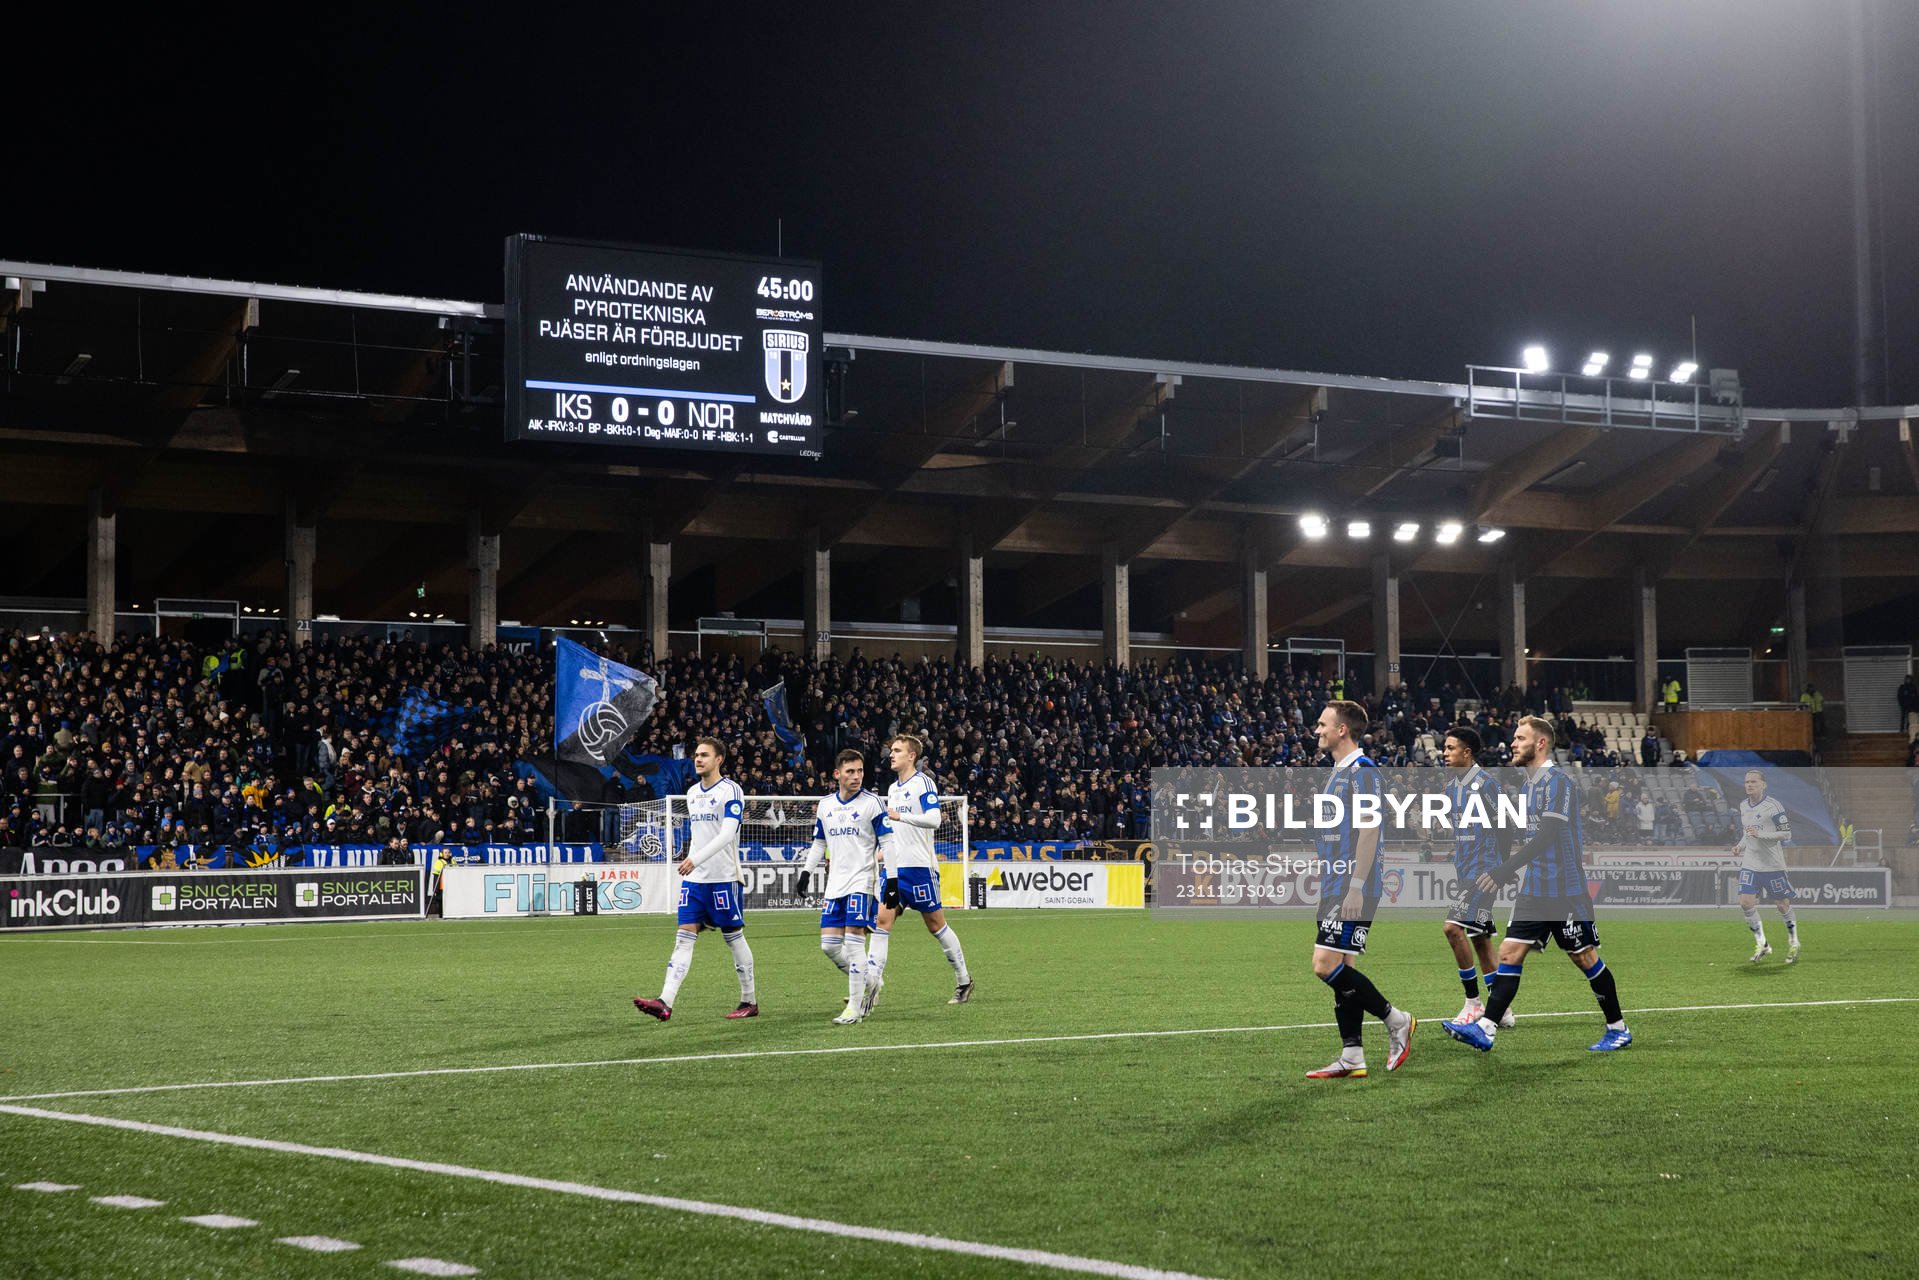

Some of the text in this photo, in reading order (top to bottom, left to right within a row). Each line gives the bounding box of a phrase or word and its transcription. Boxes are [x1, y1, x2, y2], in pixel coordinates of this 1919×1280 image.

[565, 274, 714, 302] ANVÄNDANDE AV
[757, 276, 813, 302] 45:00
[574, 298, 706, 325] PYROTEKNISKA
[539, 319, 743, 352] PJÄSER ÄR FÖRBJUDET
[767, 333, 805, 350] SIRIUS
[585, 352, 700, 371] enligt ordningslagen
[555, 392, 593, 420] IKS
[611, 396, 629, 423] 0
[657, 399, 675, 426] 0
[688, 401, 735, 429] NOR
[760, 411, 812, 426] MATCHVÅRD
[297, 620, 311, 631] 21
[817, 631, 830, 642] 20
[1388, 663, 1400, 673] 19
[1009, 866, 1093, 891] weber
[1584, 870, 1606, 880] EAM
[1625, 871, 1639, 880] EL
[1639, 871, 1648, 880] &
[1648, 871, 1668, 880] VVS
[1669, 871, 1682, 880] AB
[180, 883, 277, 898] SNICKERI
[322, 880, 414, 894] SNICKERI
[1823, 883, 1878, 903] System
[10, 888, 120, 917] inkClub
[180, 897, 277, 910] PORTALEN
[321, 893, 414, 907] PORTALEN
[767, 898, 803, 907] EN DEL AV
